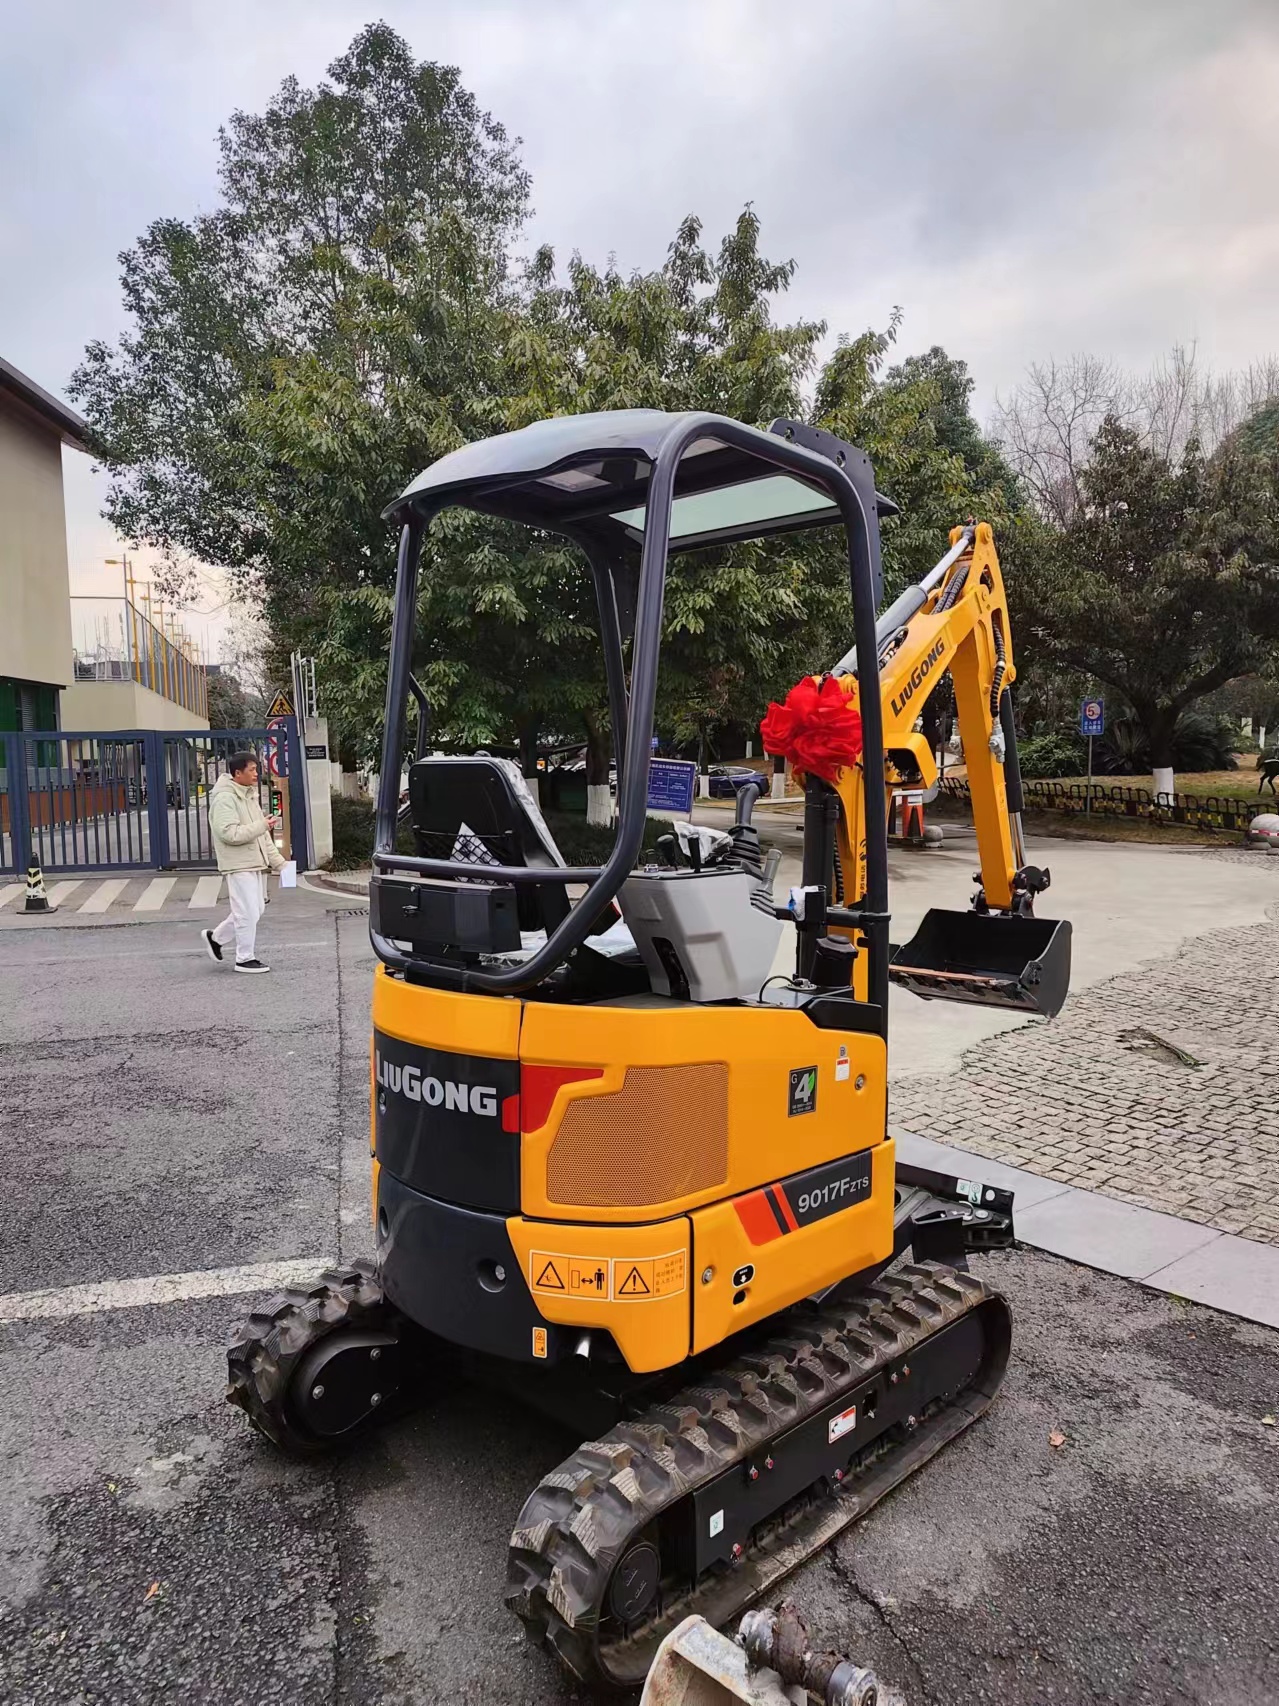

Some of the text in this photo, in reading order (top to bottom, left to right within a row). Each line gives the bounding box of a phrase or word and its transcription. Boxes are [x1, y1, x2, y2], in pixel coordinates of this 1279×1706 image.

[890, 637, 945, 717] LIUGONG
[376, 1049, 497, 1117] LIUGONG
[791, 1073, 798, 1084] G
[794, 1072, 812, 1103] 4
